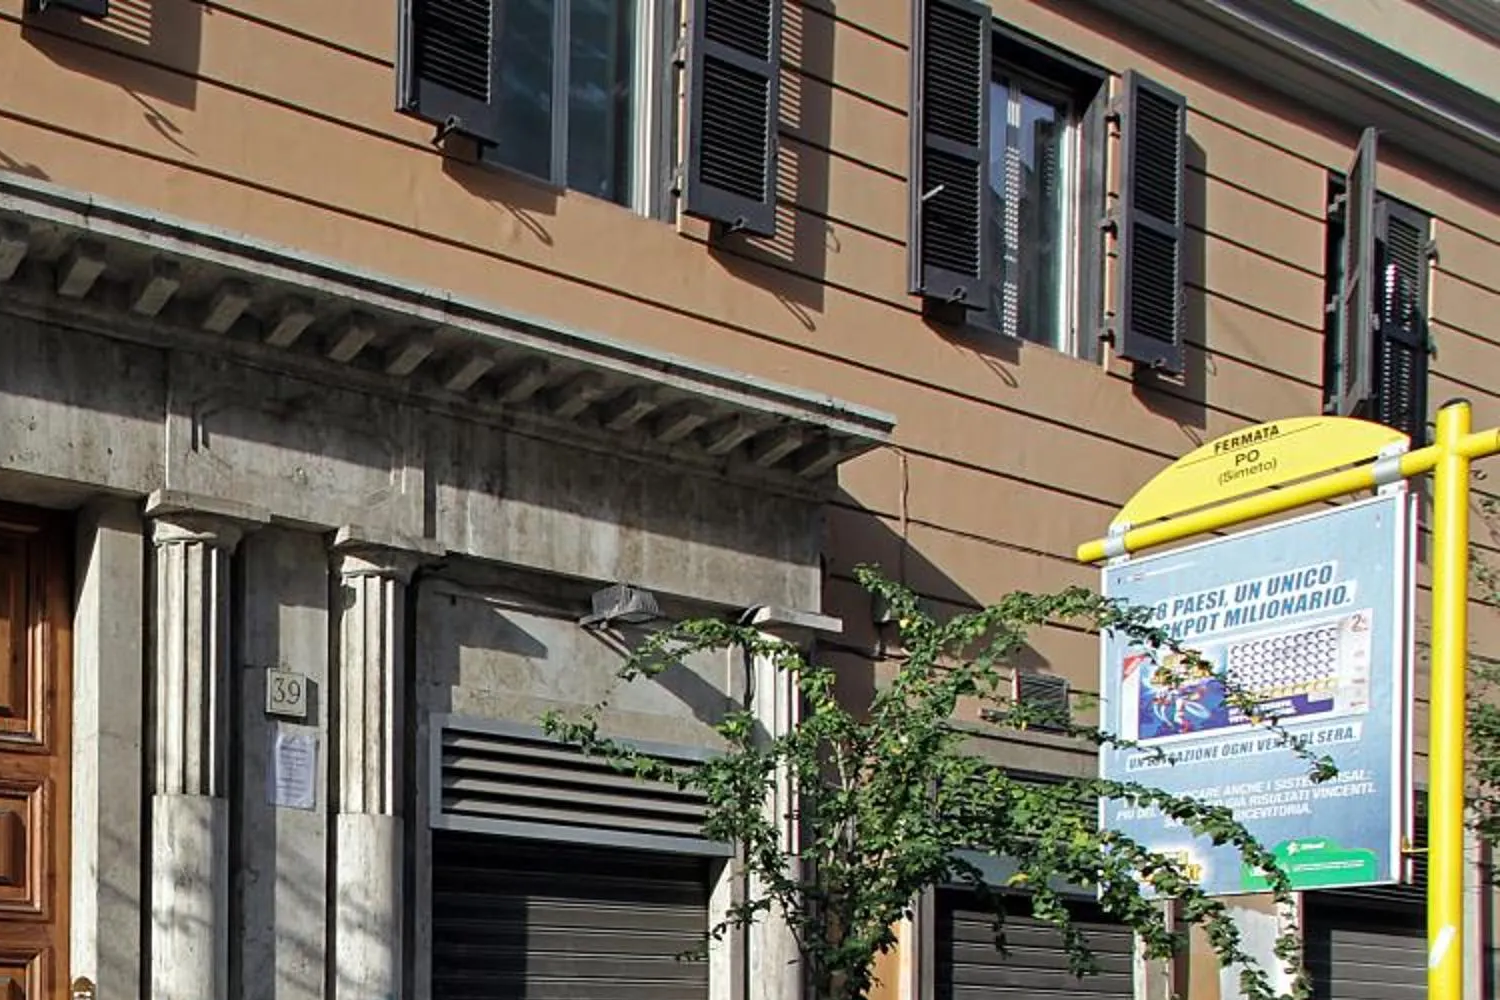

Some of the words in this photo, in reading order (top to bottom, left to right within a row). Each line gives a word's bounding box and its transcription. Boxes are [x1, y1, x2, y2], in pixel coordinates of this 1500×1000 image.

[1214, 425, 1279, 455] FERMATA
[1235, 449, 1260, 467] PO
[1172, 588, 1229, 617] PAESI,
[1234, 581, 1262, 603] UN
[1267, 565, 1333, 597] UNICO
[1223, 585, 1352, 628] MILIONARIO.
[273, 677, 301, 705] 39
[1222, 741, 1253, 758] OGNI
[1318, 726, 1357, 744] SERA.
